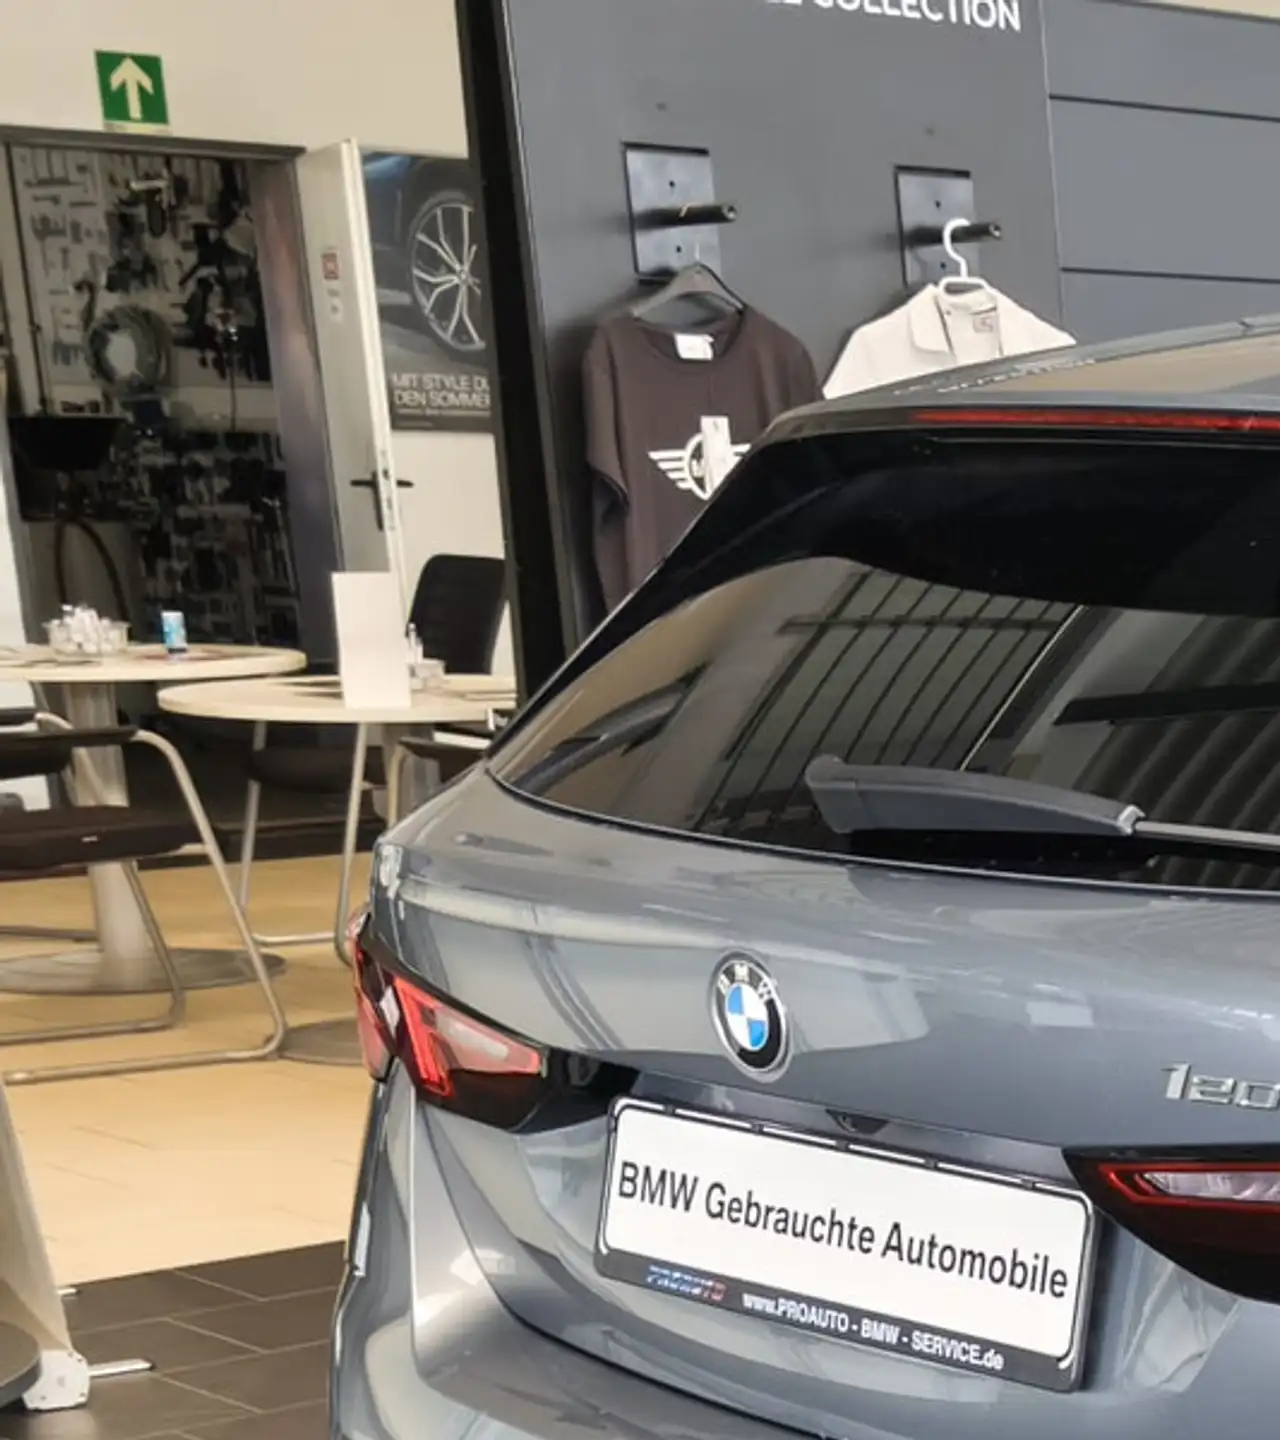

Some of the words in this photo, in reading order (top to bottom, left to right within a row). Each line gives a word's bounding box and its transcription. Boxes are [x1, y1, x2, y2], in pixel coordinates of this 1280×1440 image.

[422, 373, 472, 391] STYLE
[393, 389, 426, 406] DEN
[428, 390, 491, 409] SOMME
[619, 1161, 699, 1213] BMW
[704, 1181, 876, 1254] Gebrauchte
[881, 1221, 1068, 1298] Automobile
[860, 1317, 900, 1345] BMW
